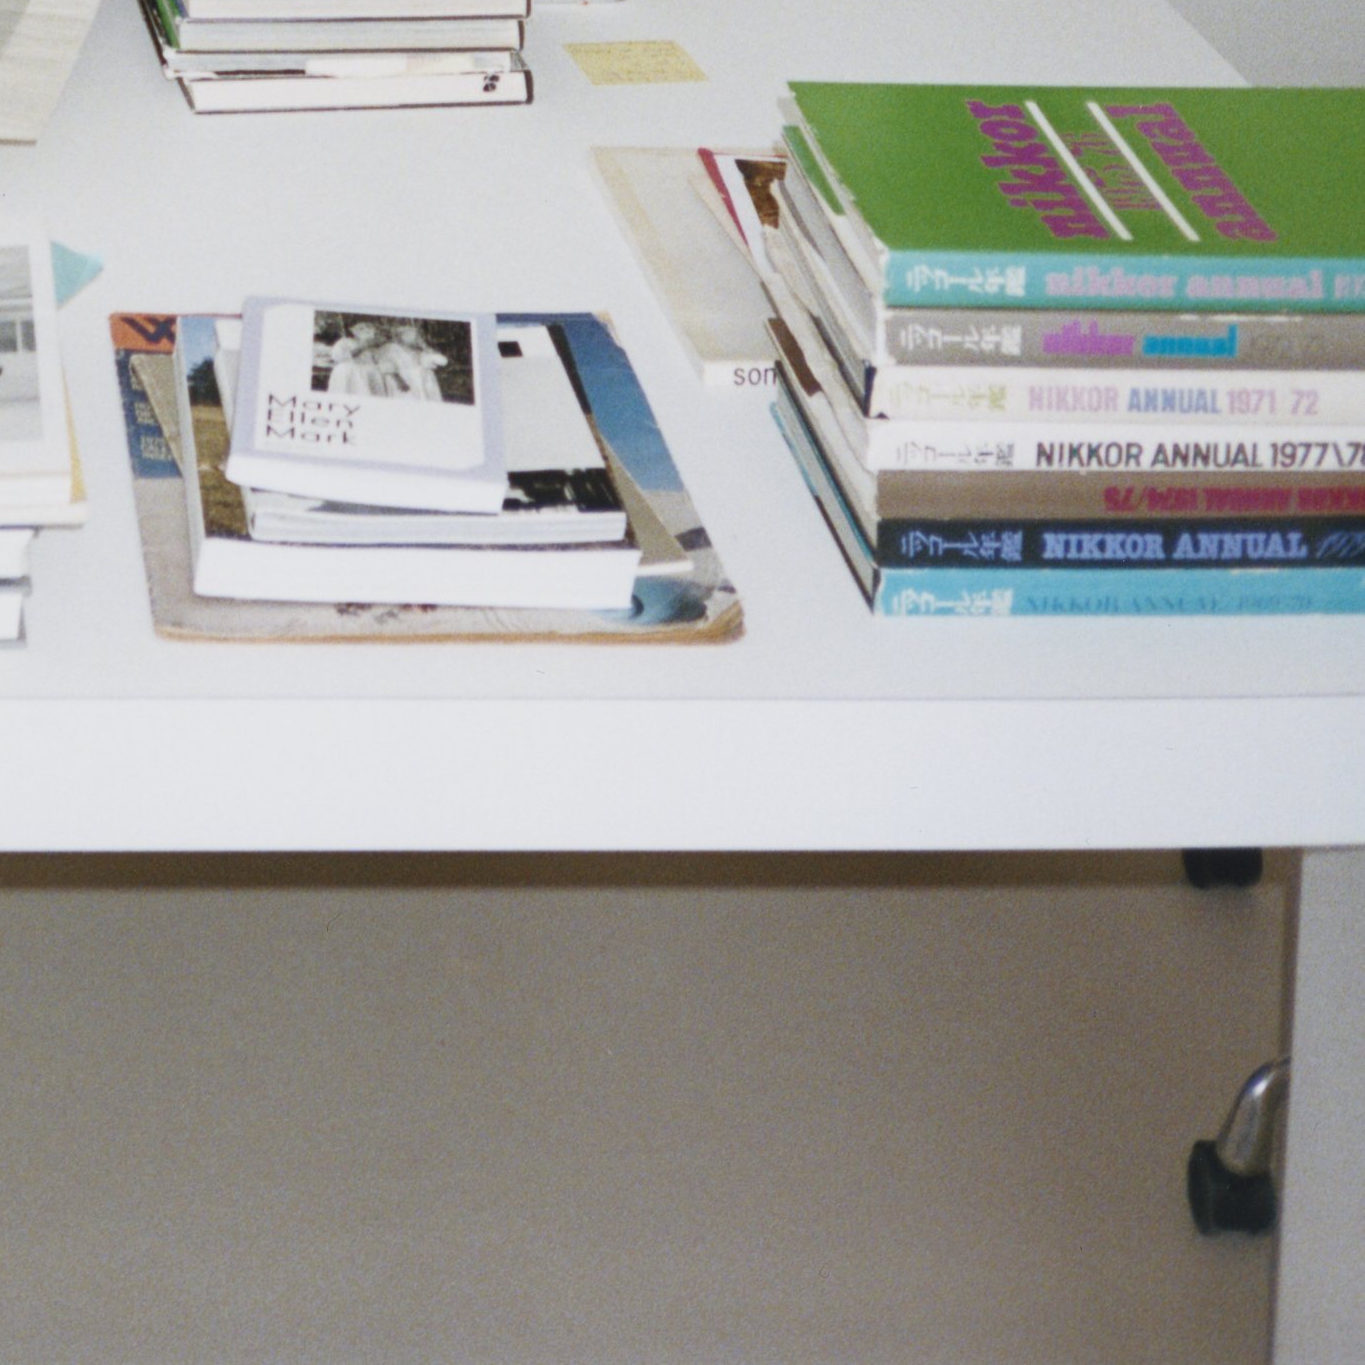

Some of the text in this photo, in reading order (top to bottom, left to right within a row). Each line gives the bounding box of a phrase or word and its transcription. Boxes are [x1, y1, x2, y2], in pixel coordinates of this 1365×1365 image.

[965, 98, 1111, 240] nikkor
[1104, 102, 1279, 243] annual
[267, 393, 361, 417] Mary
[1028, 385, 1120, 412] NIKKOR
[1126, 388, 1223, 414] ANNUAL
[267, 408, 354, 428] Ellen
[266, 424, 356, 445] Mark
[1036, 442, 1365, 468] NIKKOR ANNUAL 1977\7
[1042, 533, 1165, 560] NIKKOR
[1172, 532, 1309, 559] ANNUAL
